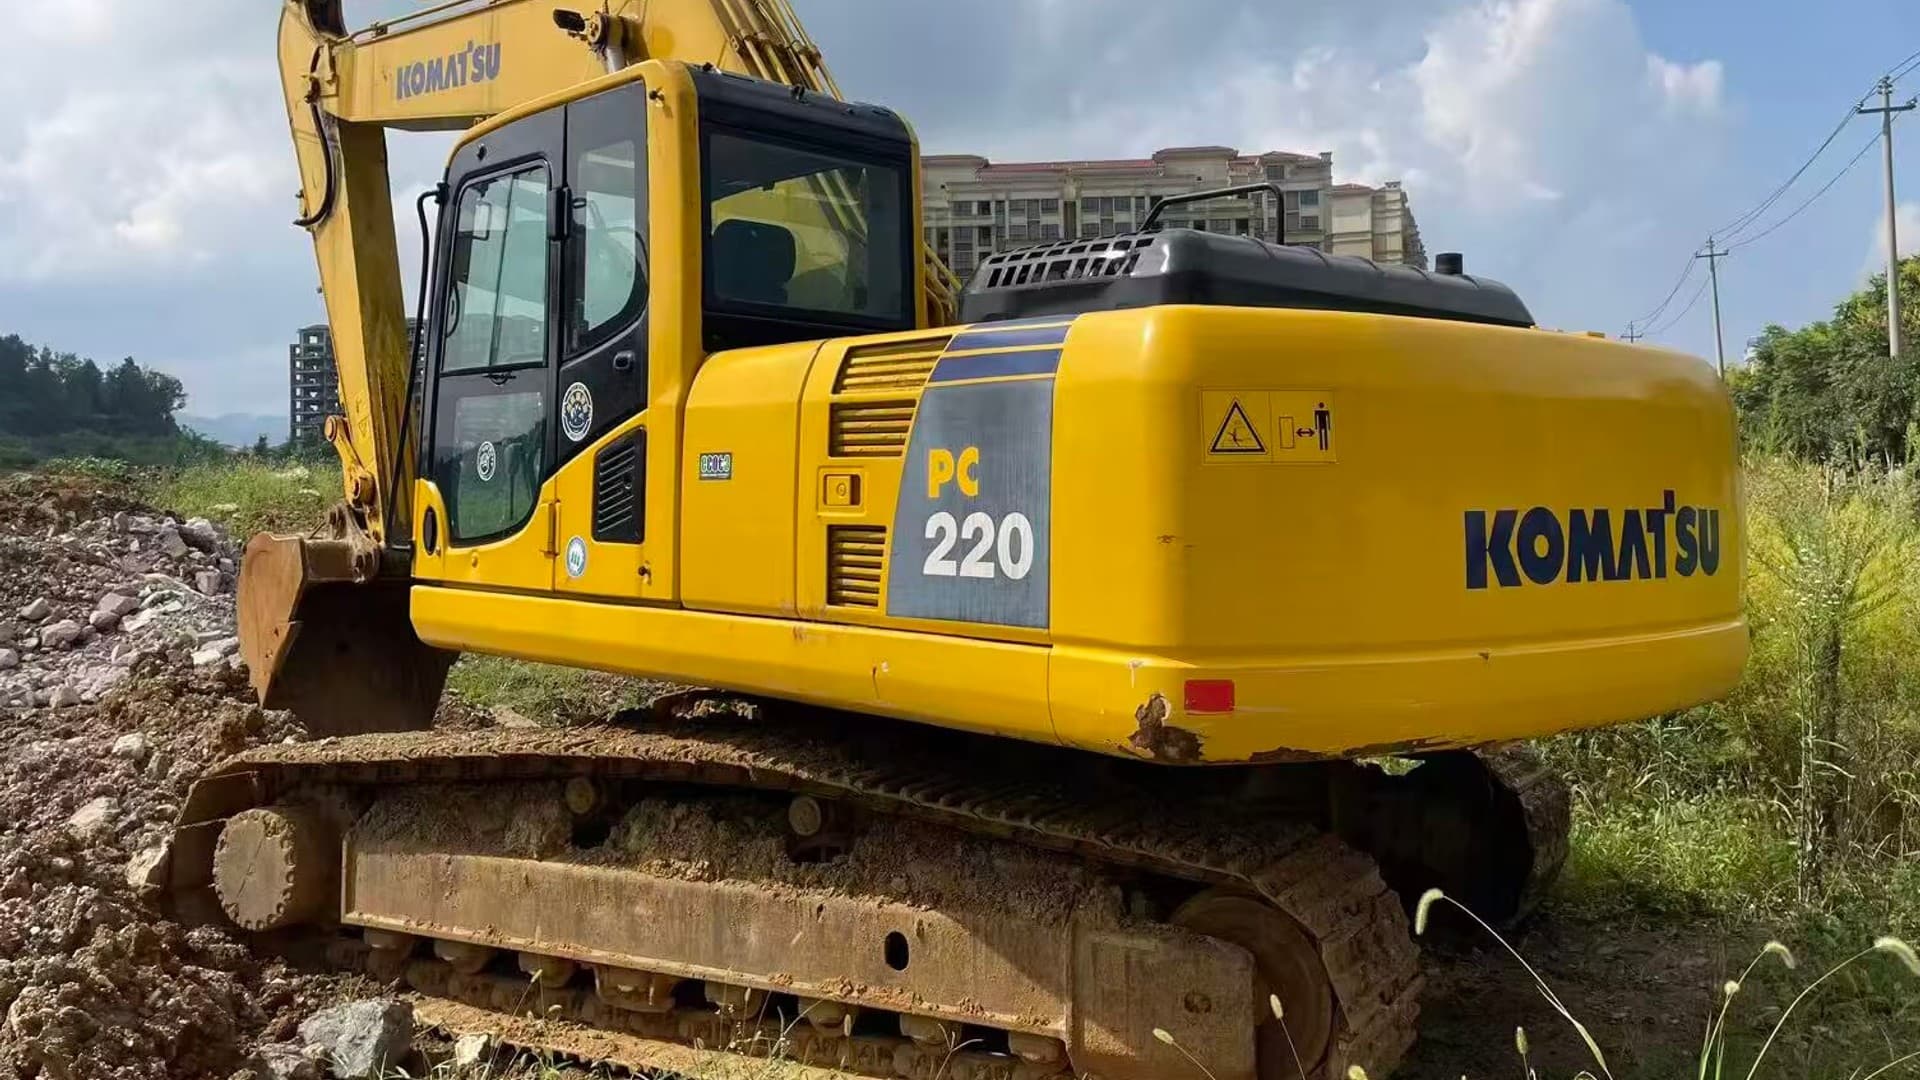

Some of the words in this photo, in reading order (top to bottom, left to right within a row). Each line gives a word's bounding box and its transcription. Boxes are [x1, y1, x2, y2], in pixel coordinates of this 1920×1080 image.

[397, 40, 501, 100] KOMATSU
[928, 446, 979, 498] PC
[923, 511, 1034, 580] 220
[1464, 490, 1719, 589] KOMATSU
